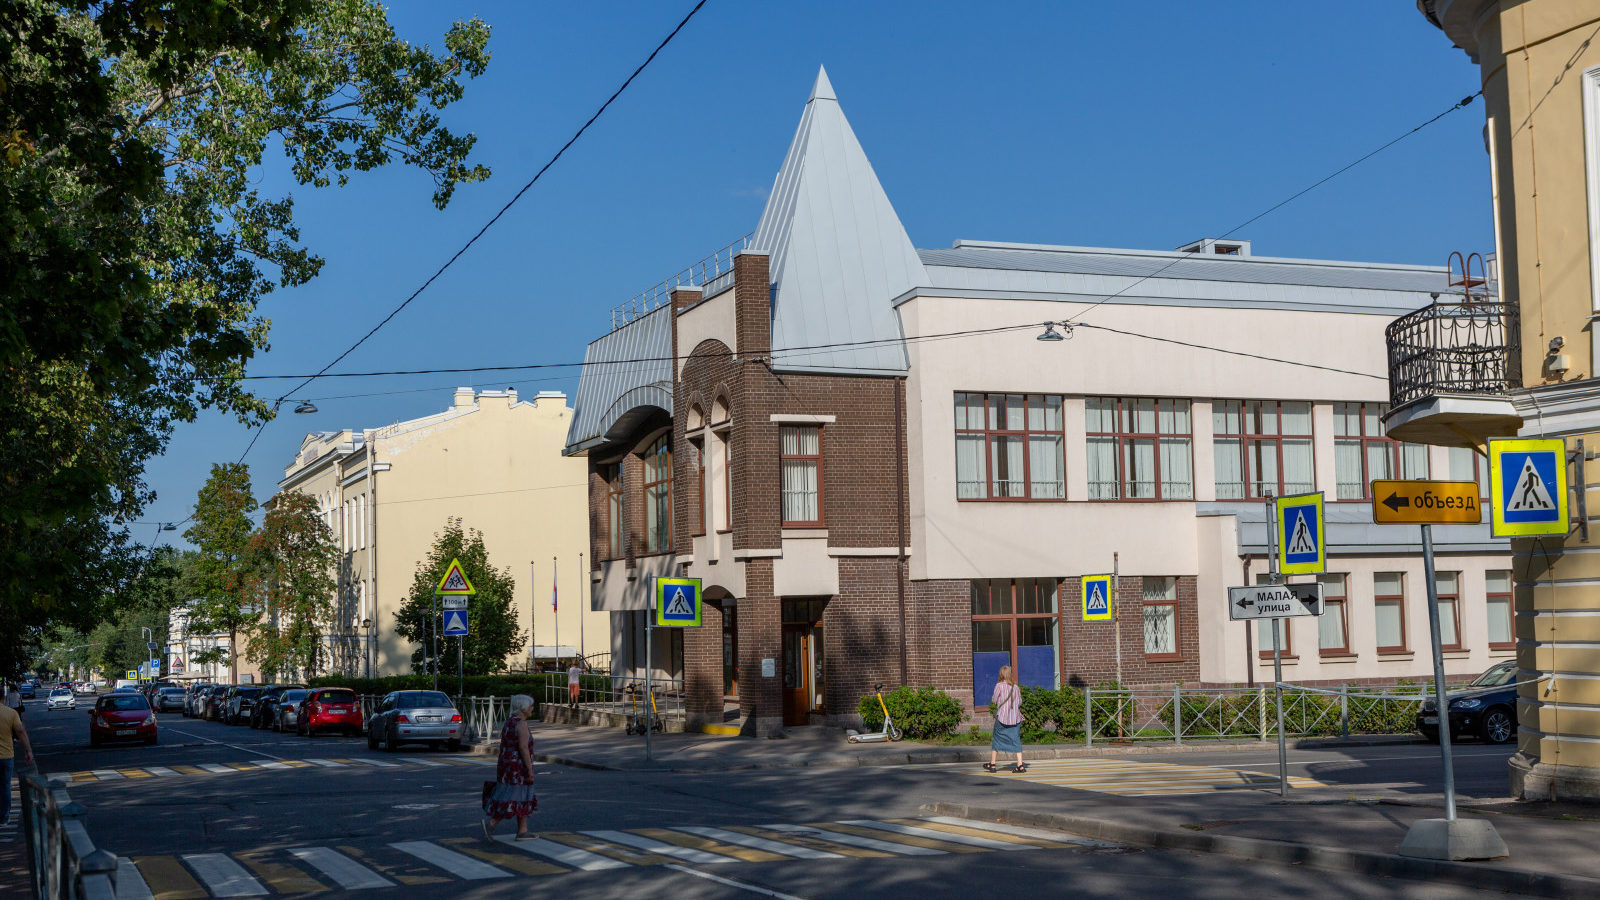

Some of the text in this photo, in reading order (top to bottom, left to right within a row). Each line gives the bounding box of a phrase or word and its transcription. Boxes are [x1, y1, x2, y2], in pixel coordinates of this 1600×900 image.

[1414, 491, 1475, 511] объезд
[1257, 591, 1298, 601] МАЛАЯ
[1257, 604, 1291, 615] улица
